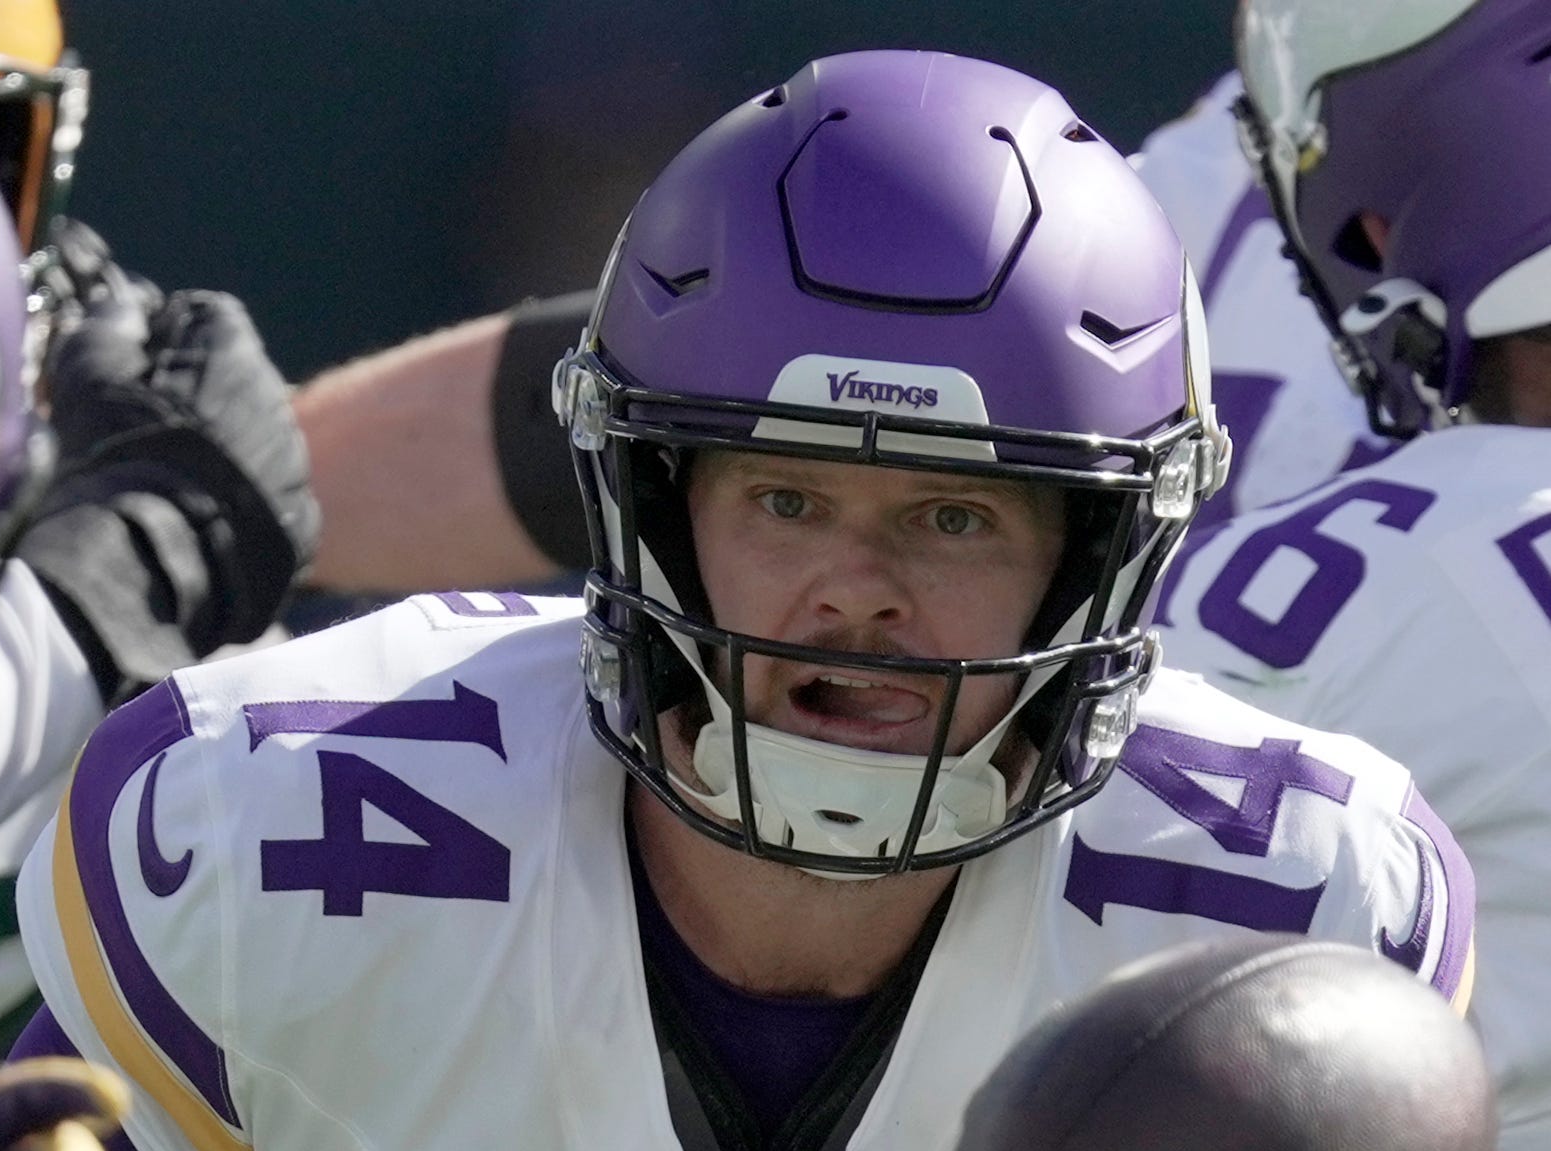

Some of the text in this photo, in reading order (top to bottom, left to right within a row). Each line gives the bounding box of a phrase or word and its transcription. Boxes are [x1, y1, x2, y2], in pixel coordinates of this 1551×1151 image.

[1152, 478, 1438, 669] 6
[243, 679, 511, 917] 14
[1063, 723, 1355, 934] 14
